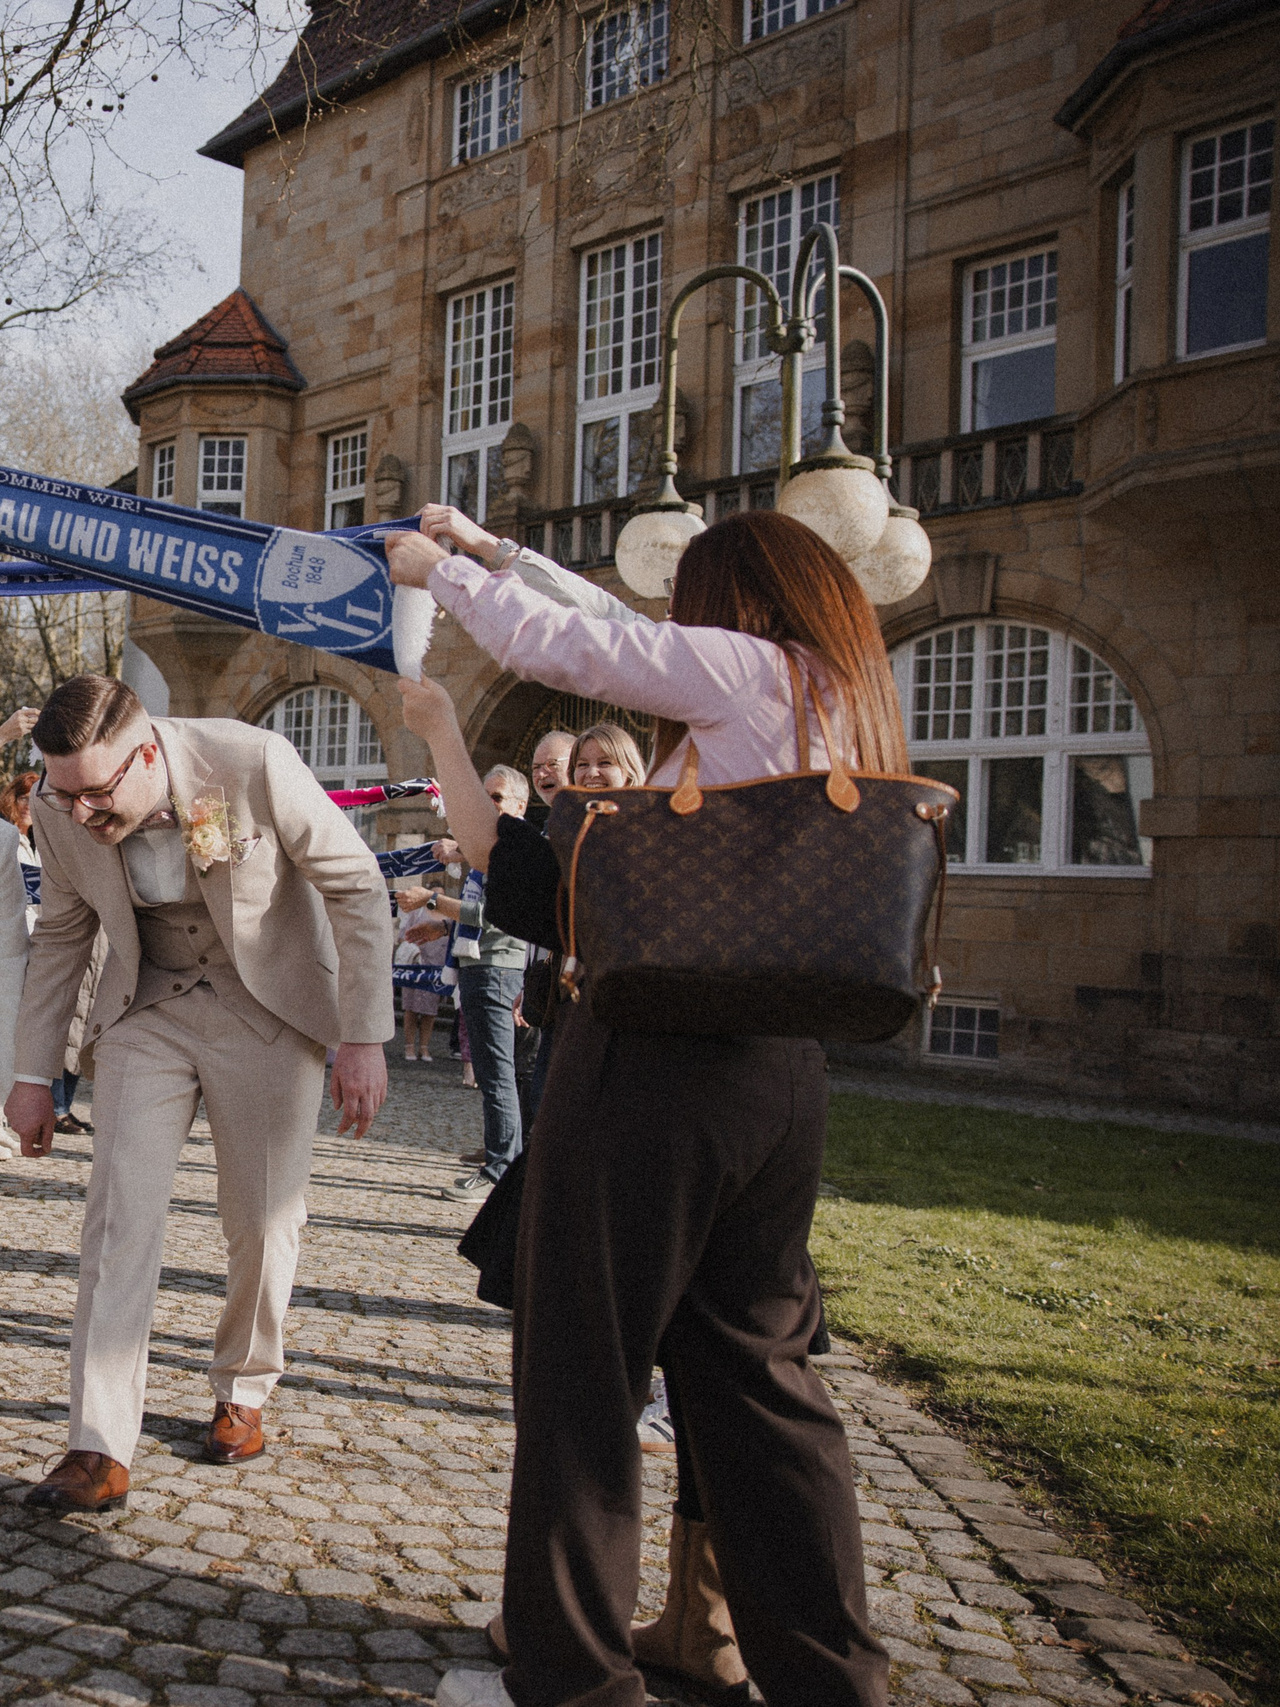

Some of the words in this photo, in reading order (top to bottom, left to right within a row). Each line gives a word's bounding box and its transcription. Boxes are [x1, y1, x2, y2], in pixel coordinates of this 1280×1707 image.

[87, 490, 141, 513] WIR!
[48, 506, 122, 563] UND
[127, 527, 245, 595] WEISS
[282, 545, 305, 589] Bochum
[305, 556, 326, 585] 1848
